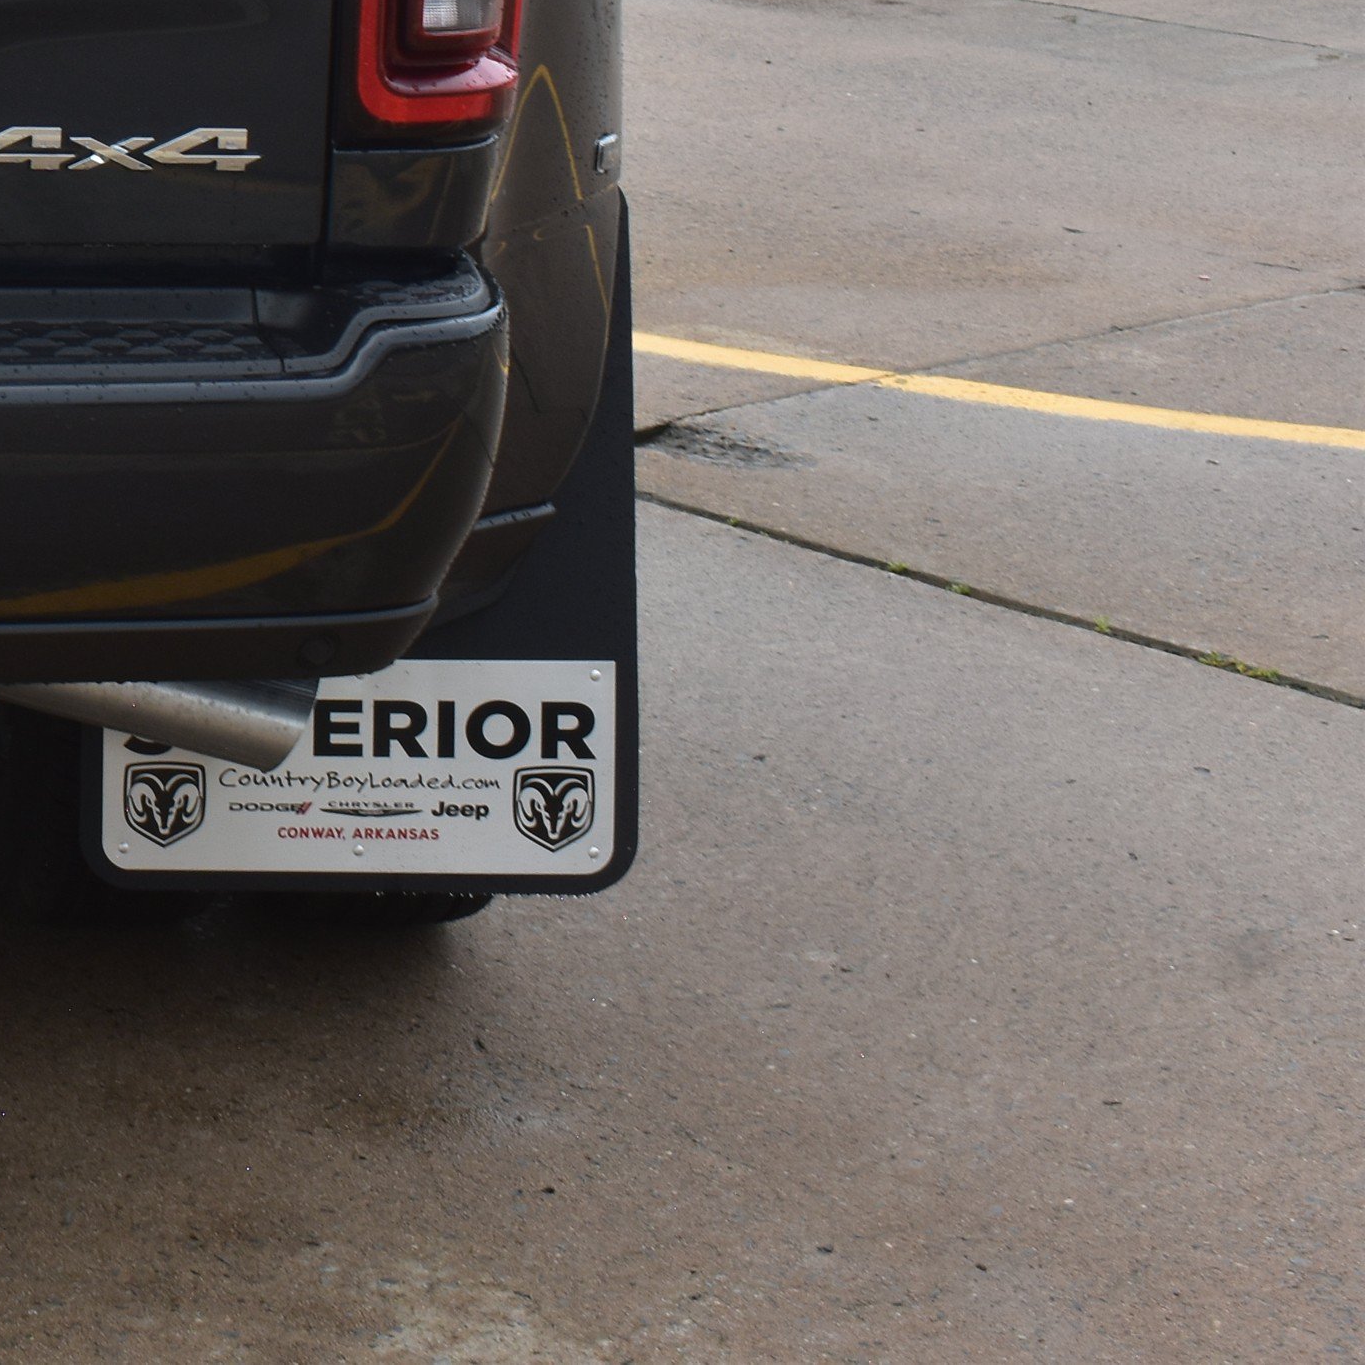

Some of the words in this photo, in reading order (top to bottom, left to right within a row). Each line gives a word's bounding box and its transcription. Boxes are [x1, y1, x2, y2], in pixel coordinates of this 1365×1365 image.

[123, 699, 597, 760] ERIOR
[219, 767, 501, 792] CountryBoyLoaded.com
[229, 802, 305, 812] DODGE
[431, 801, 490, 820] Jeep
[277, 827, 346, 841] CONWAY,
[351, 827, 440, 841] ARKANSAS
